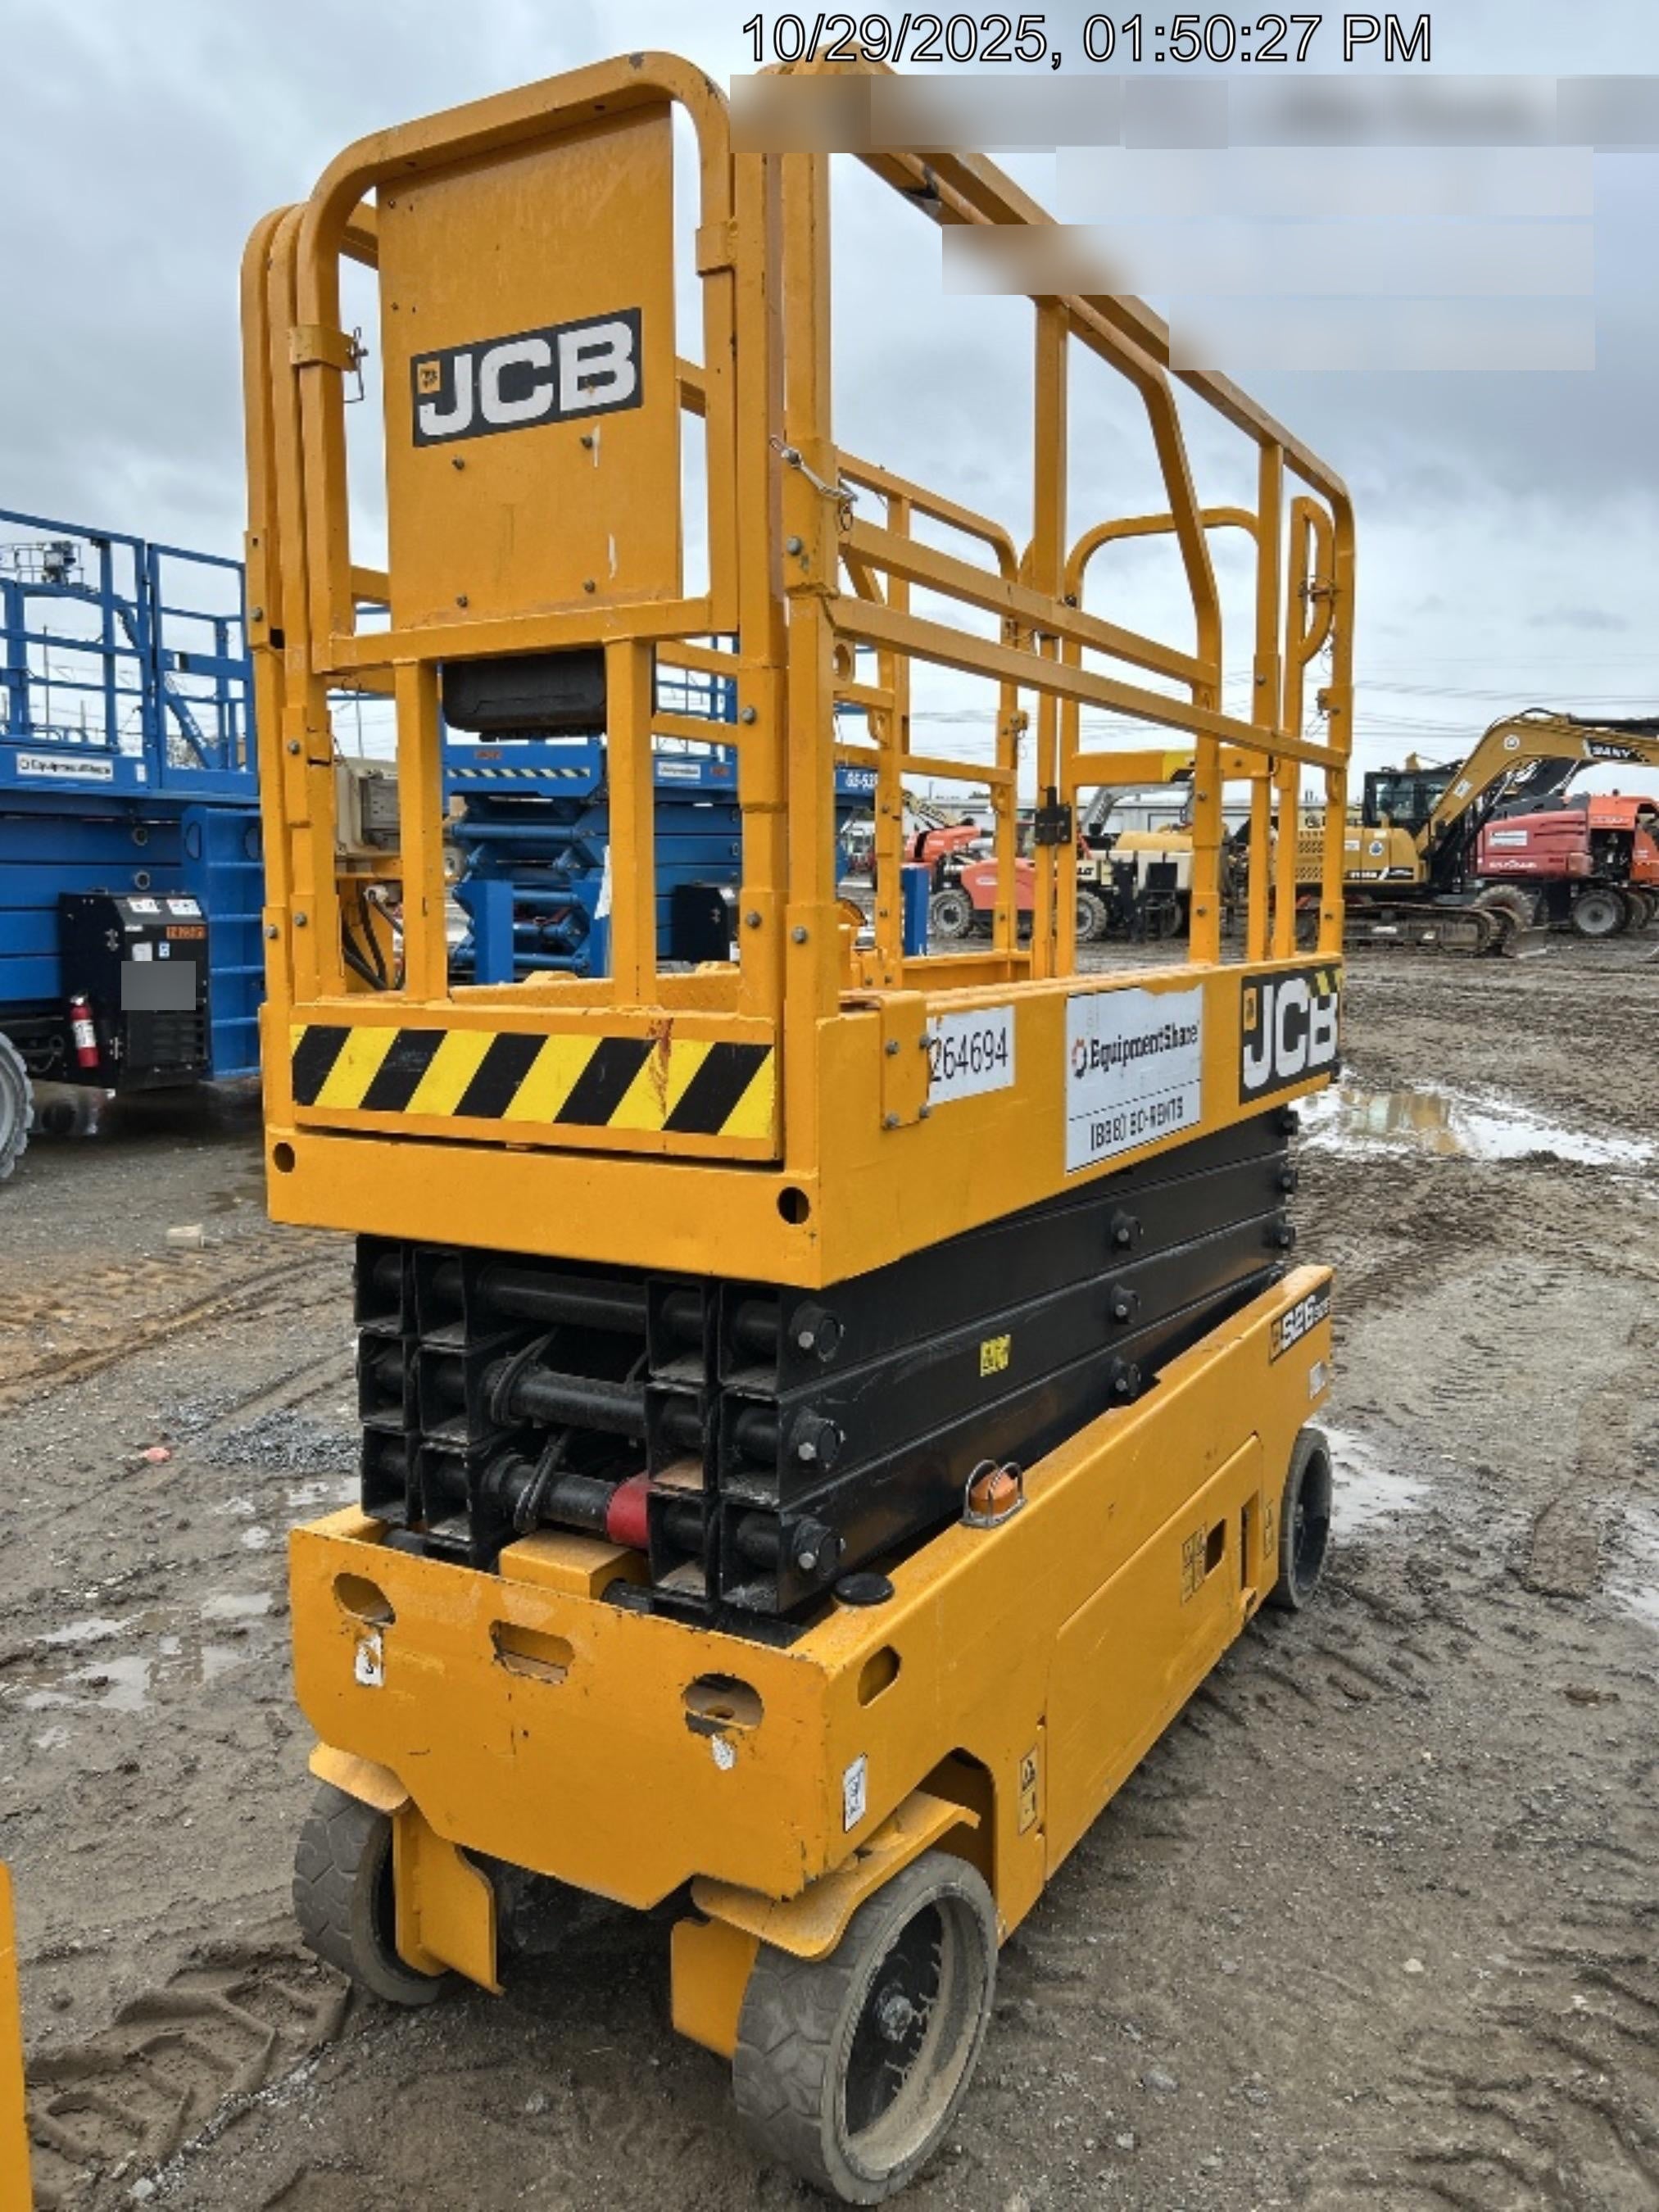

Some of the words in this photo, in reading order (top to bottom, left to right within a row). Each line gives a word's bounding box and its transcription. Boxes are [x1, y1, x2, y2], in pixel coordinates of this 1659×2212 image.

[419, 321, 636, 436] JCB
[1090, 1023, 1198, 1072] EquipmentShare
[1243, 977, 1339, 1090] JCB
